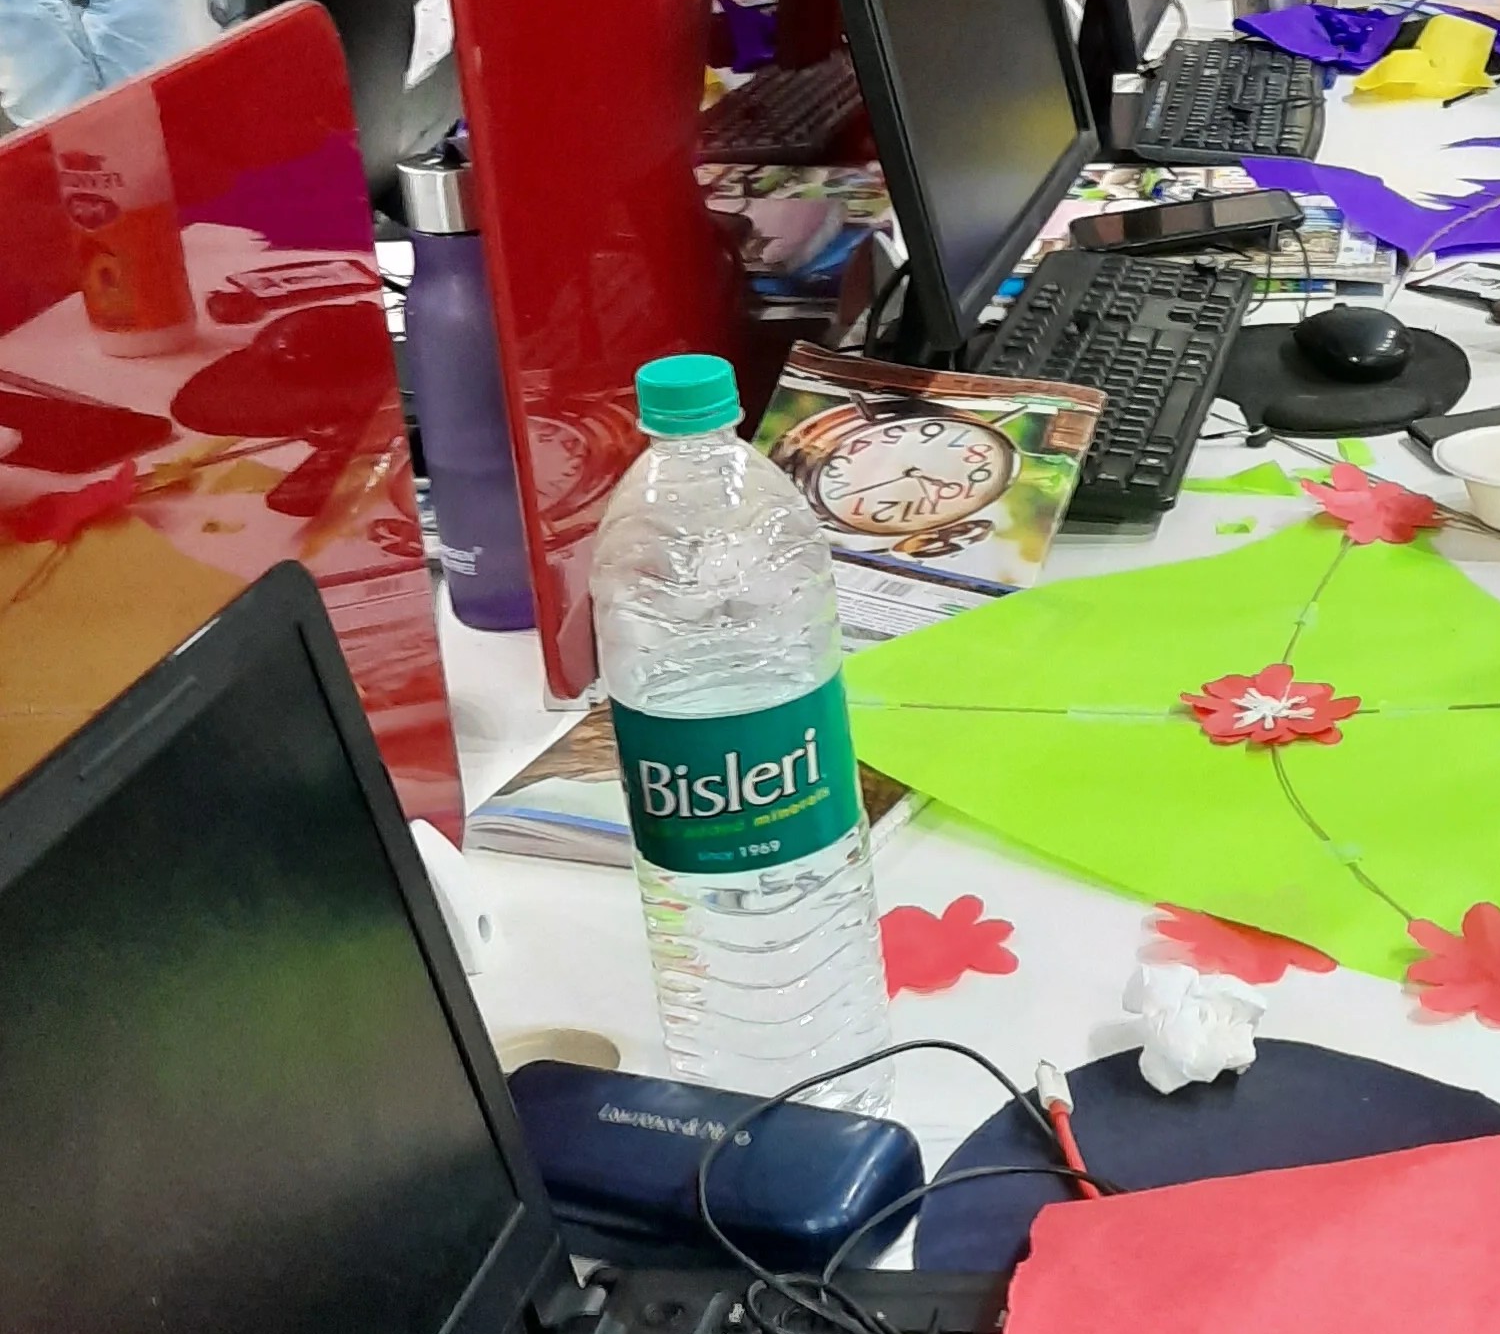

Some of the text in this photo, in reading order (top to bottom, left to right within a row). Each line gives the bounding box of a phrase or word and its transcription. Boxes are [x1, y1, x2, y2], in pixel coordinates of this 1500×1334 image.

[919, 422, 945, 444] 6
[871, 500, 913, 524] 12
[638, 727, 821, 818] Bisleri
[738, 839, 781, 857] 1969
